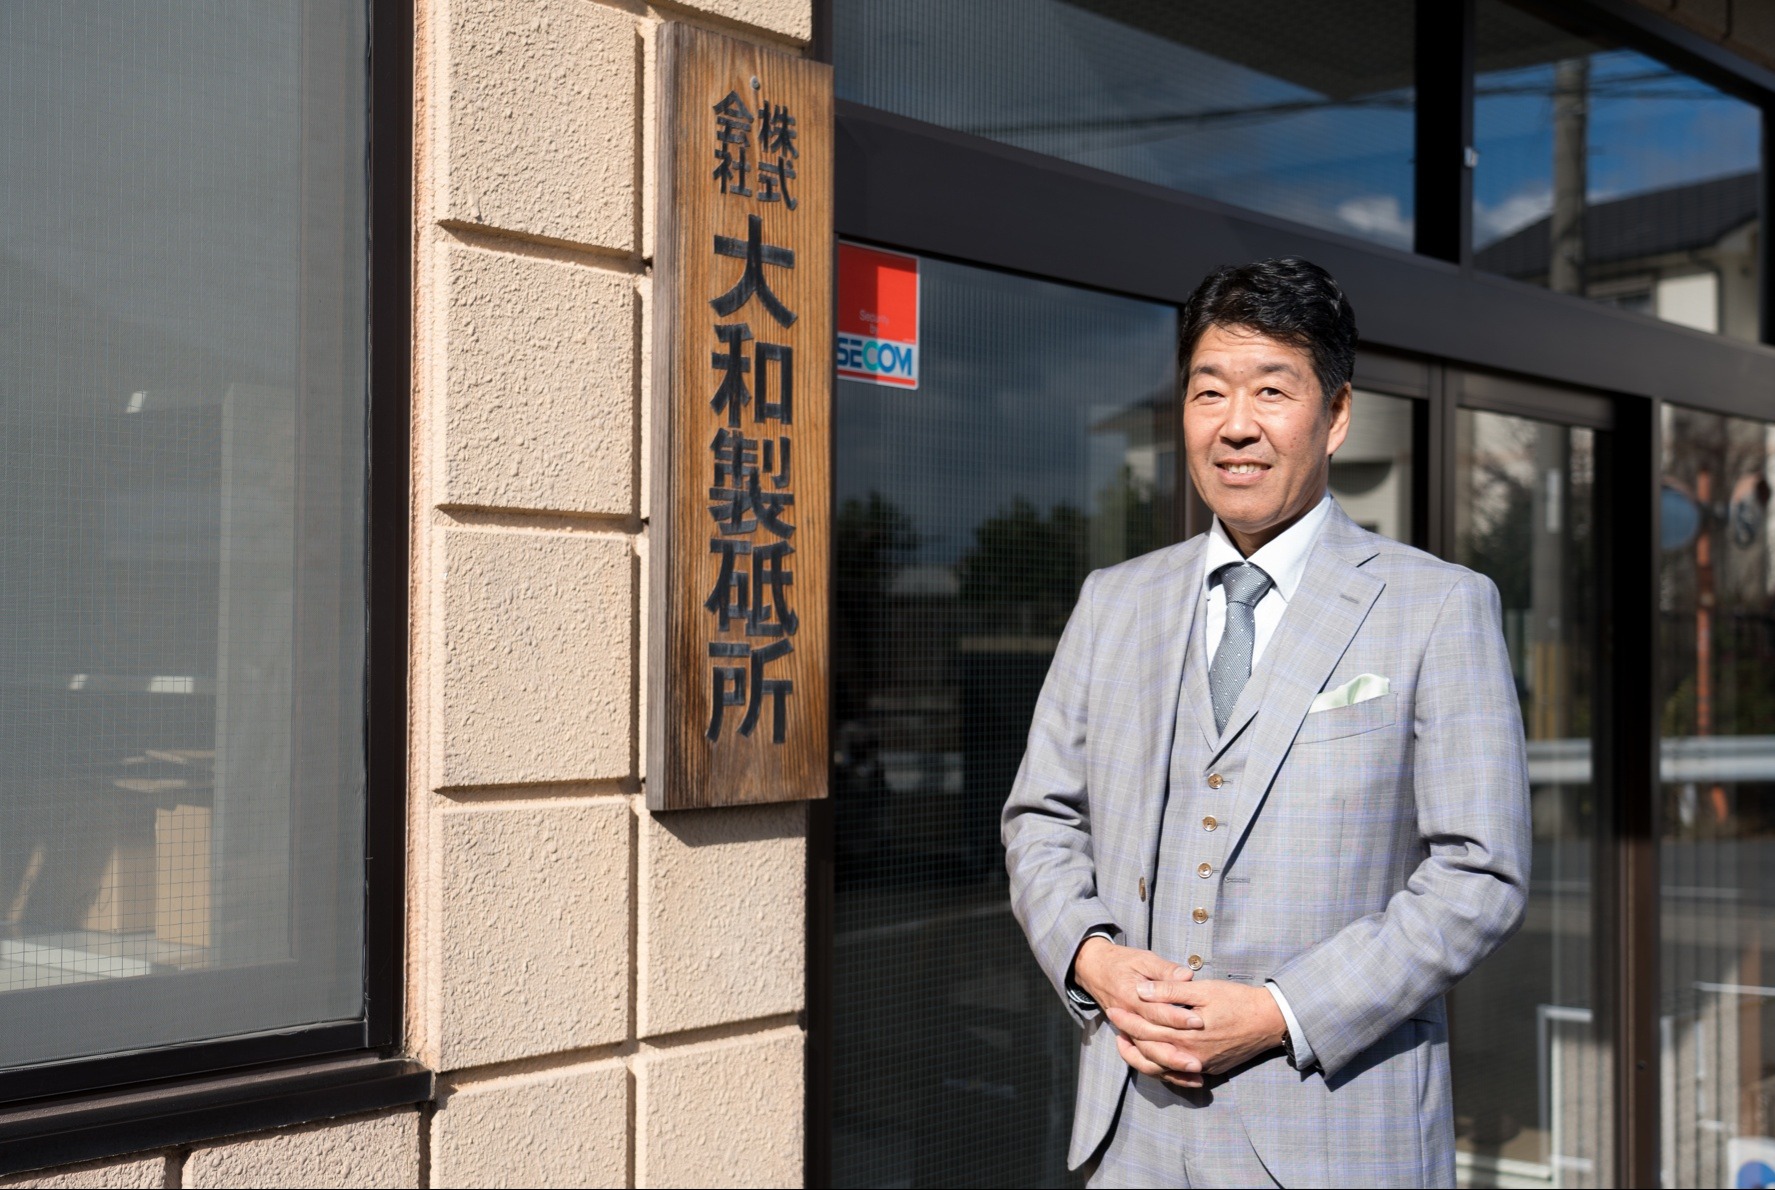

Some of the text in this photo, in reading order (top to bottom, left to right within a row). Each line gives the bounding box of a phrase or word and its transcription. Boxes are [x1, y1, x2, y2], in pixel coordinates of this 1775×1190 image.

[712, 91, 754, 198] 会社
[758, 100, 798, 211] 株式
[837, 337, 912, 376] SECOM
[706, 215, 799, 744] 大和製砥所
